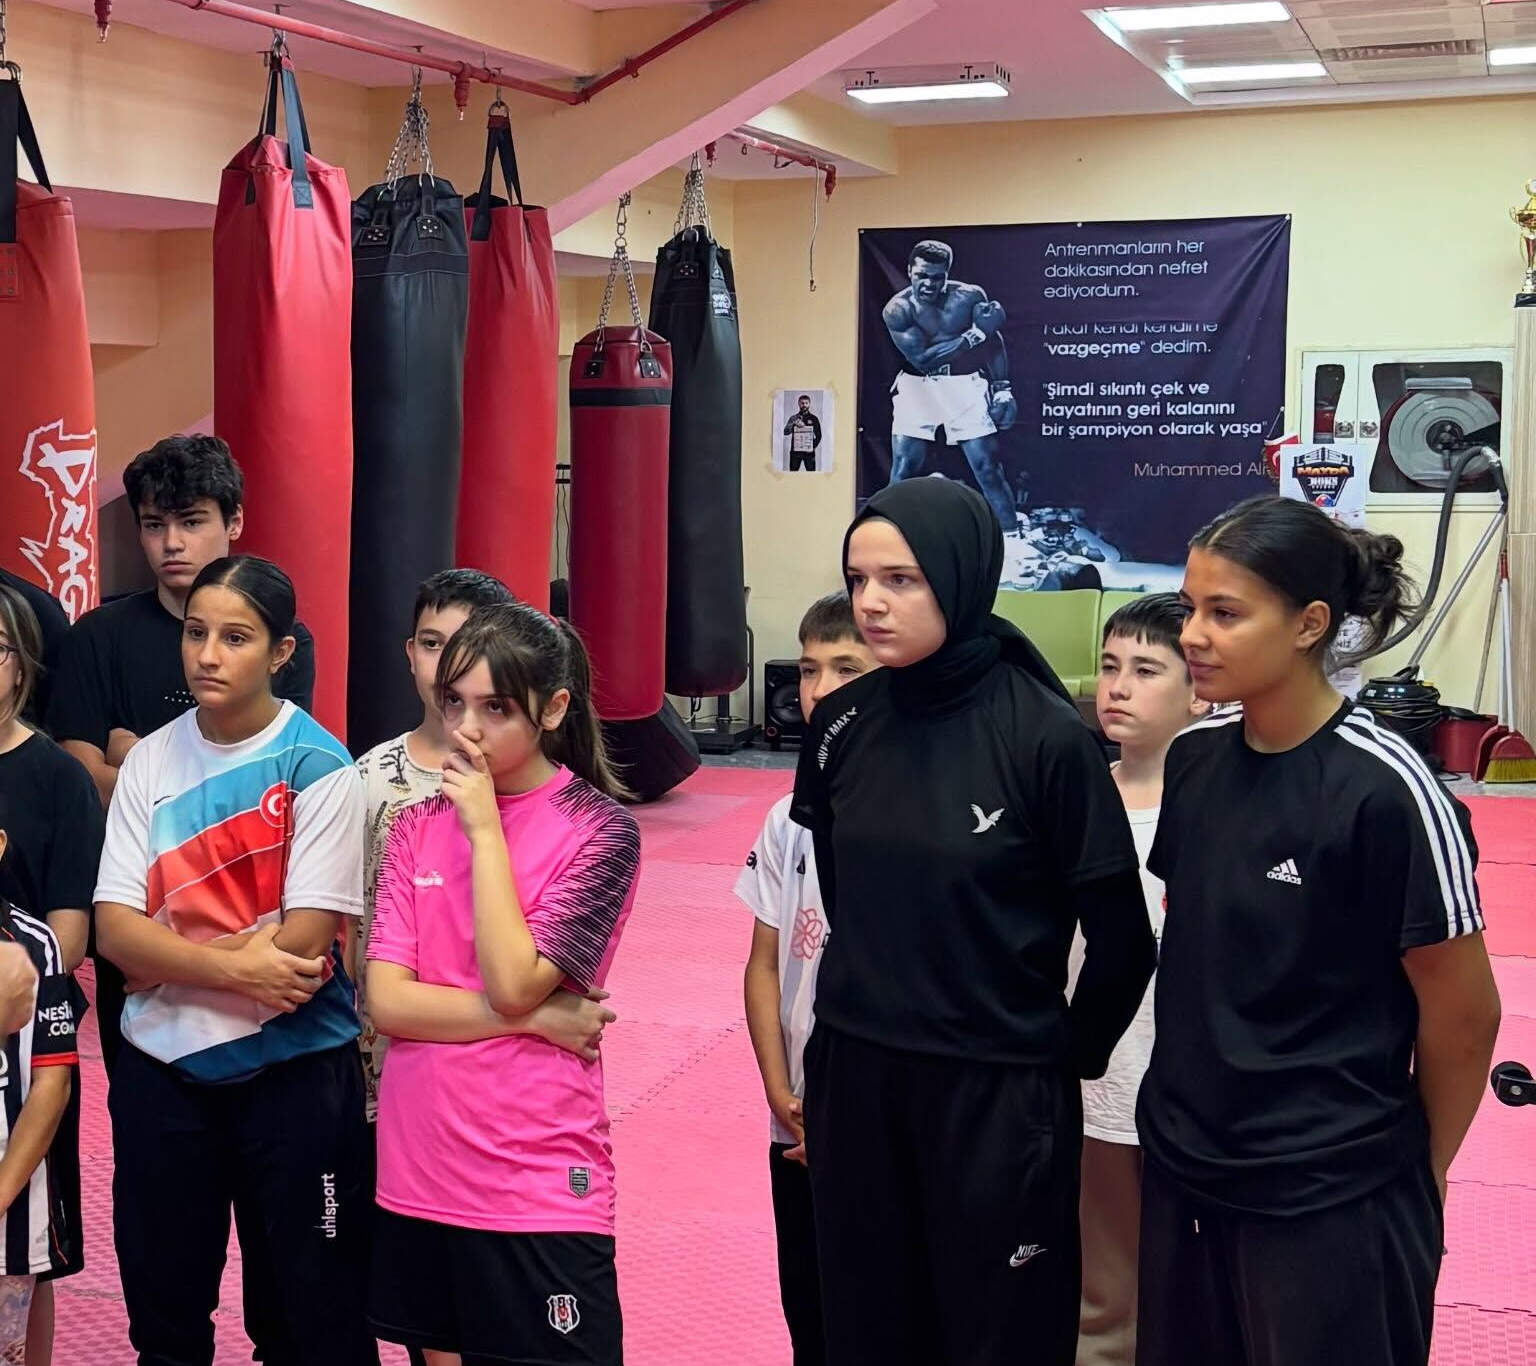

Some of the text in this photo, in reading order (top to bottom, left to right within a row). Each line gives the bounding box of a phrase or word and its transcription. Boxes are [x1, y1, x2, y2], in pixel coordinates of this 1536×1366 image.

[1044, 240, 1205, 256] Antrenmanların her
[1044, 260, 1208, 278] dakikasından nefret
[1044, 283, 1140, 300] ediyordum.
[1043, 339, 1212, 358] "vazgeçme" dedim.
[1042, 381, 1210, 400] "Şimdi sıkıntı çek ve
[1042, 402, 1235, 419] hayatının geri kalanını
[1041, 423, 1063, 436] bir
[1068, 423, 1154, 439] şampiyon
[1158, 422, 1215, 435] olarak
[1134, 462, 1242, 477] Muhammed
[37, 441, 96, 626] DRAG
[1266, 870, 1302, 885] adidas
[320, 1173, 340, 1238] uhlsport
